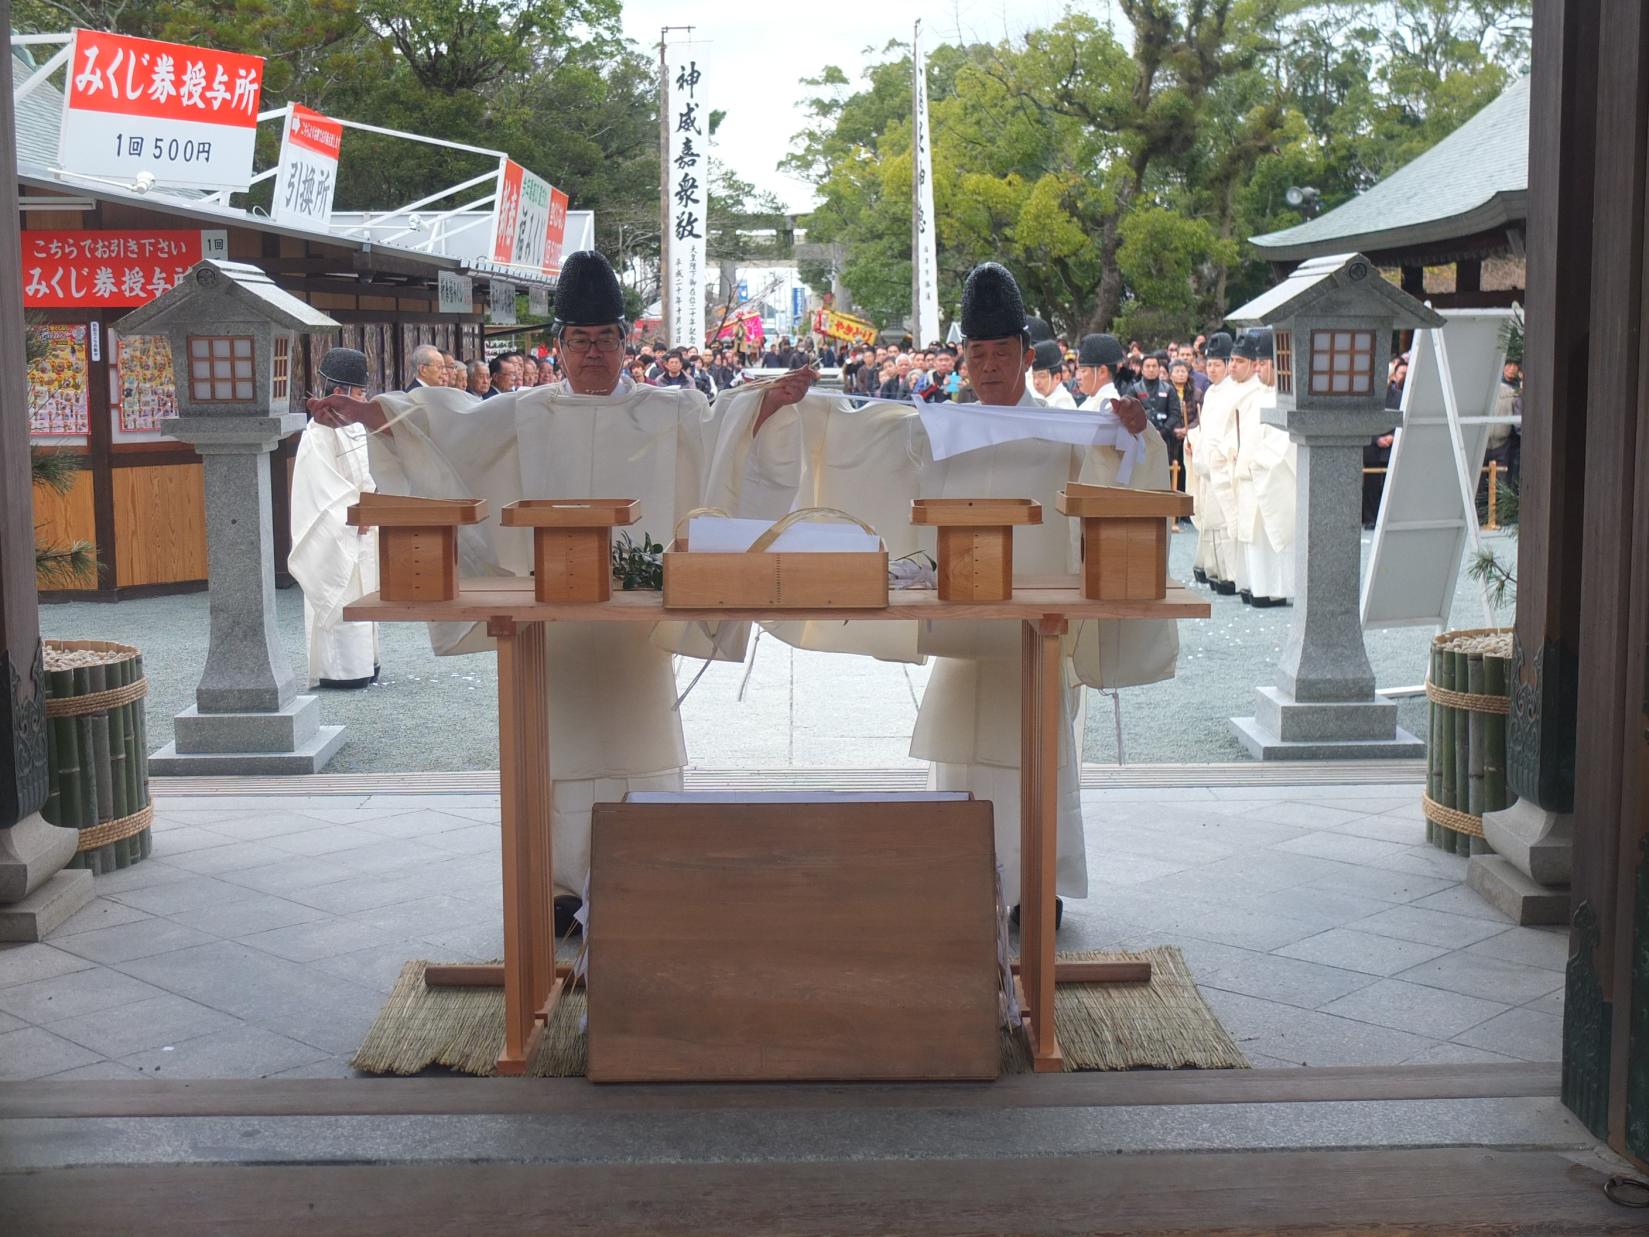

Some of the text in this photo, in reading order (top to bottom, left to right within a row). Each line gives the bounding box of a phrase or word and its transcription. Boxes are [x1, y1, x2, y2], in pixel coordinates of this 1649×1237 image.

[75, 45, 259, 116] みくじ券授与所
[115, 133, 212, 163] 1回 500円
[285, 161, 331, 221] 引換所
[33, 238, 187, 259] こちらでお引き下さい
[207, 238, 224, 251] 1回
